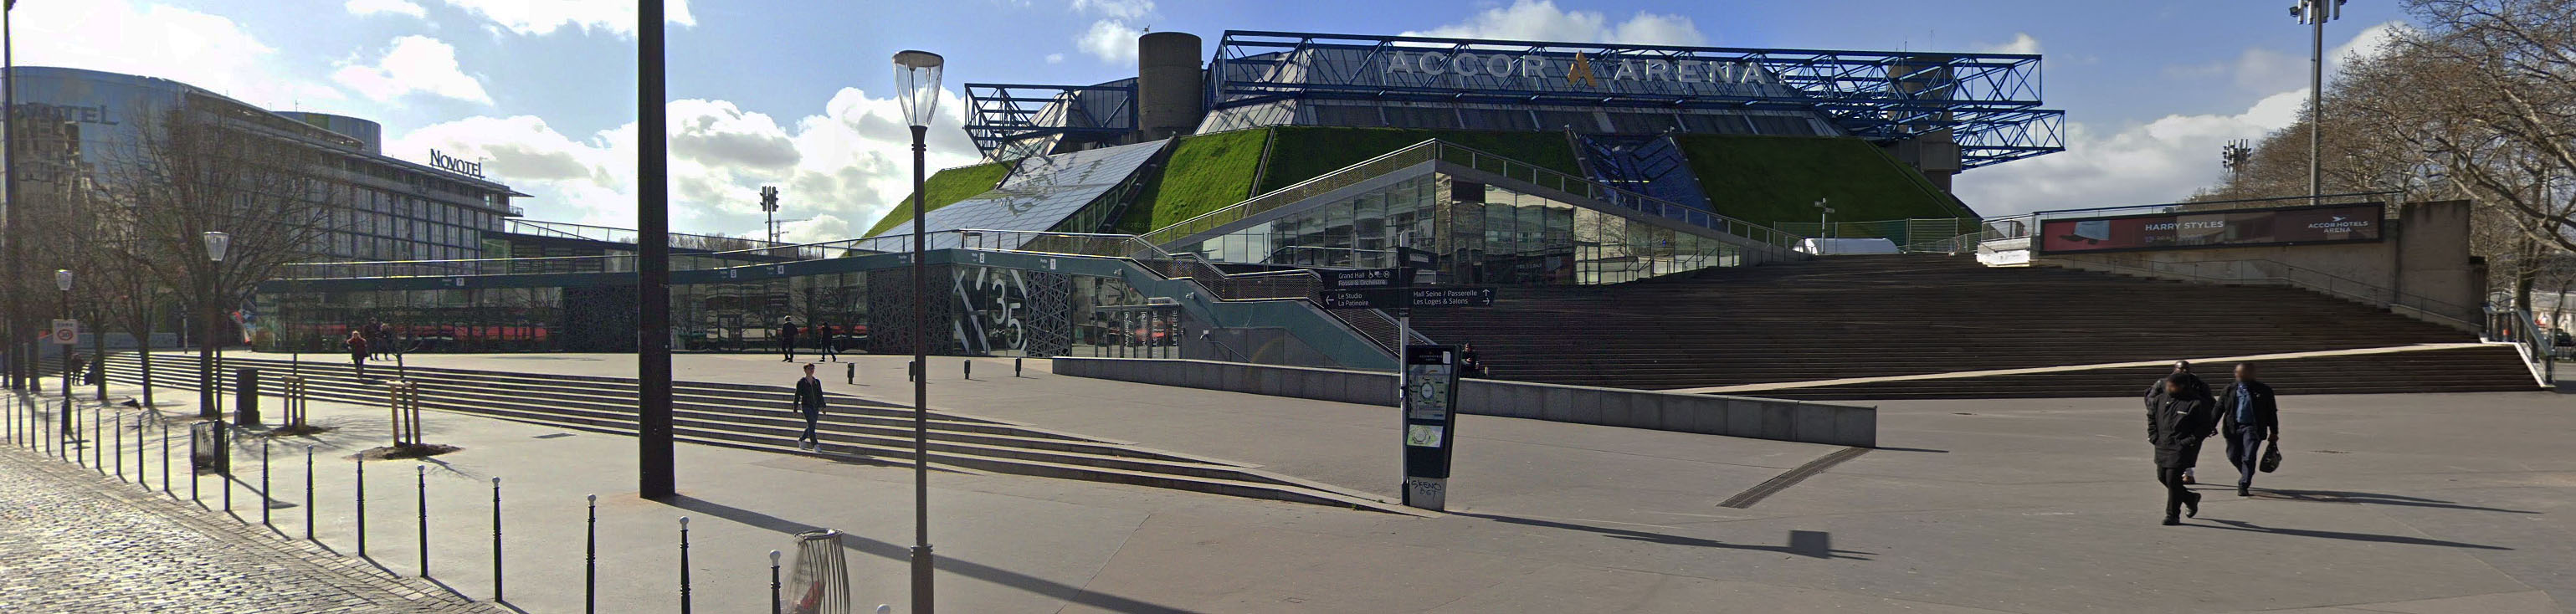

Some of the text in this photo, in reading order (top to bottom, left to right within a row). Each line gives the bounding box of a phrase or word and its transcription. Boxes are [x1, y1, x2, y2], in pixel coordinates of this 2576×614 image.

[1386, 50, 1547, 79] ACCOR
[1614, 58, 1767, 84] ARENA
[2145, 223, 2181, 231] HARRY
